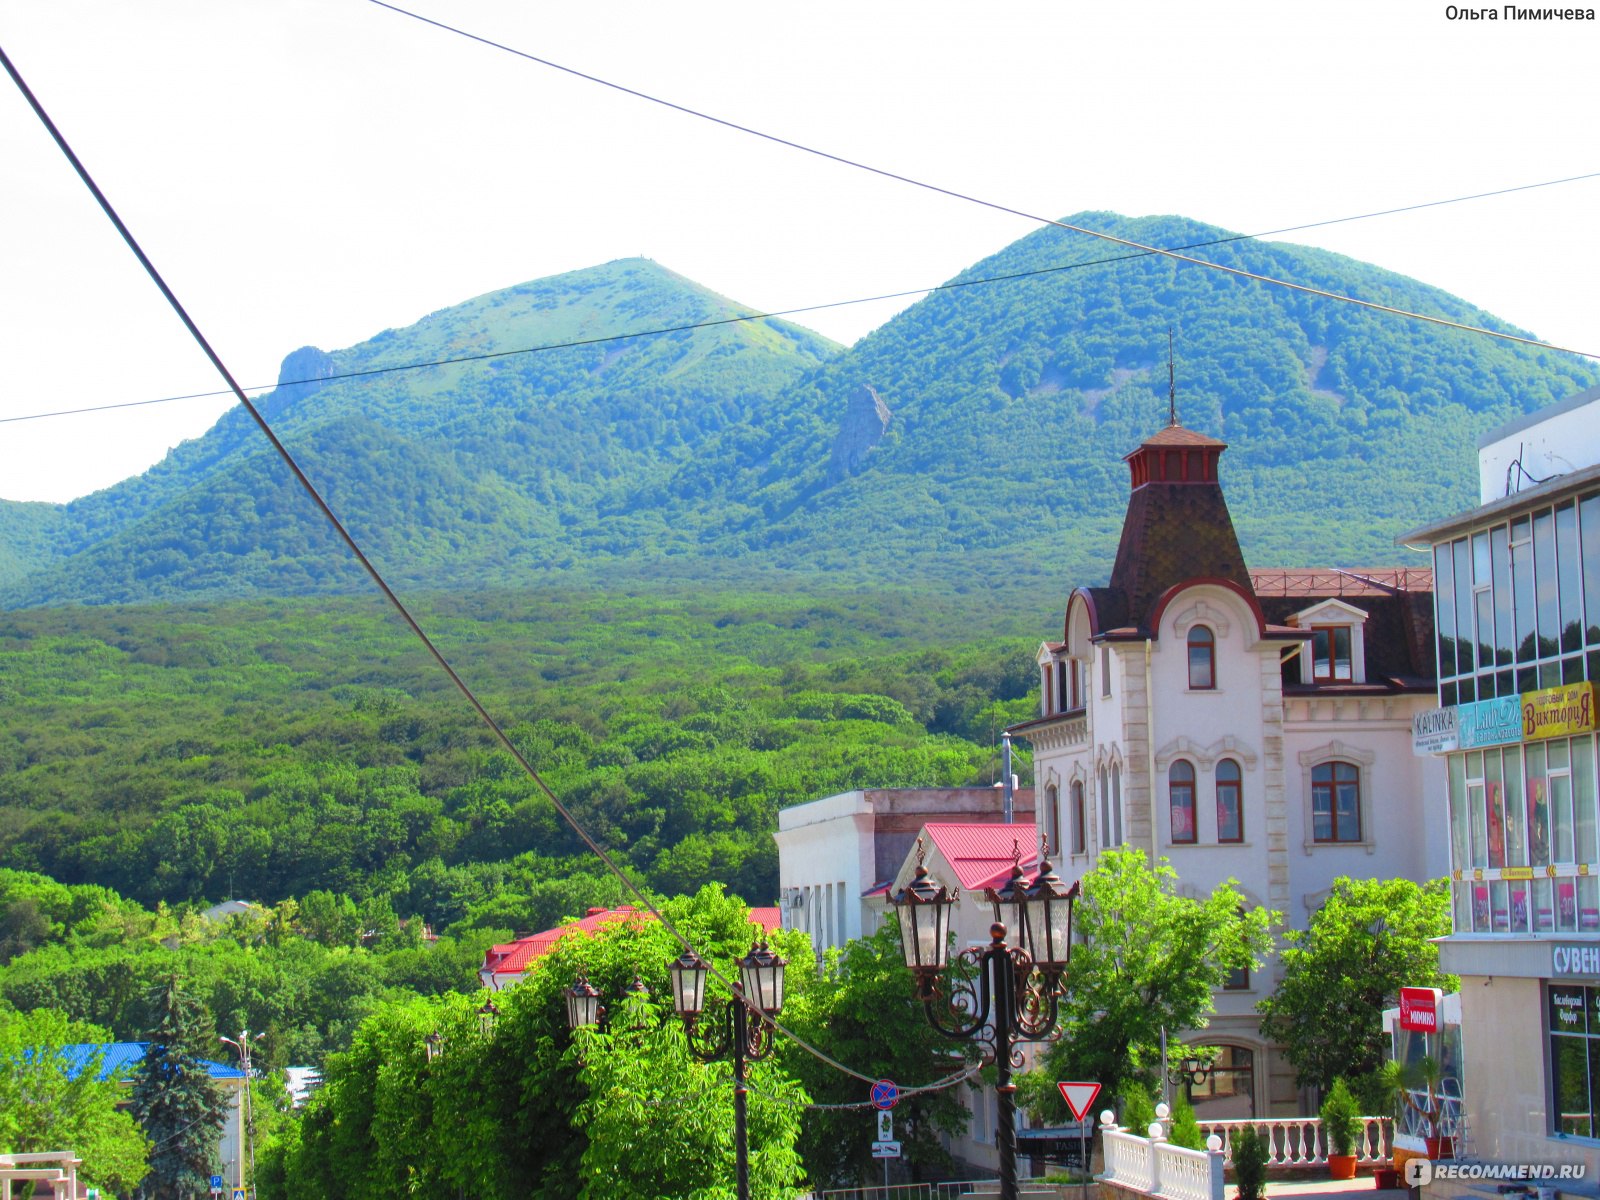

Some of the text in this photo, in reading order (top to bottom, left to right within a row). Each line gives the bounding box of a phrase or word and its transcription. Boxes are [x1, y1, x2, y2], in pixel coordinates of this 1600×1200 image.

[1416, 711, 1454, 736] KALINKA
[1475, 701, 1499, 731] Lady
[1410, 1010, 1435, 1026] МИМИНО
[213, 1177, 220, 1186] P
